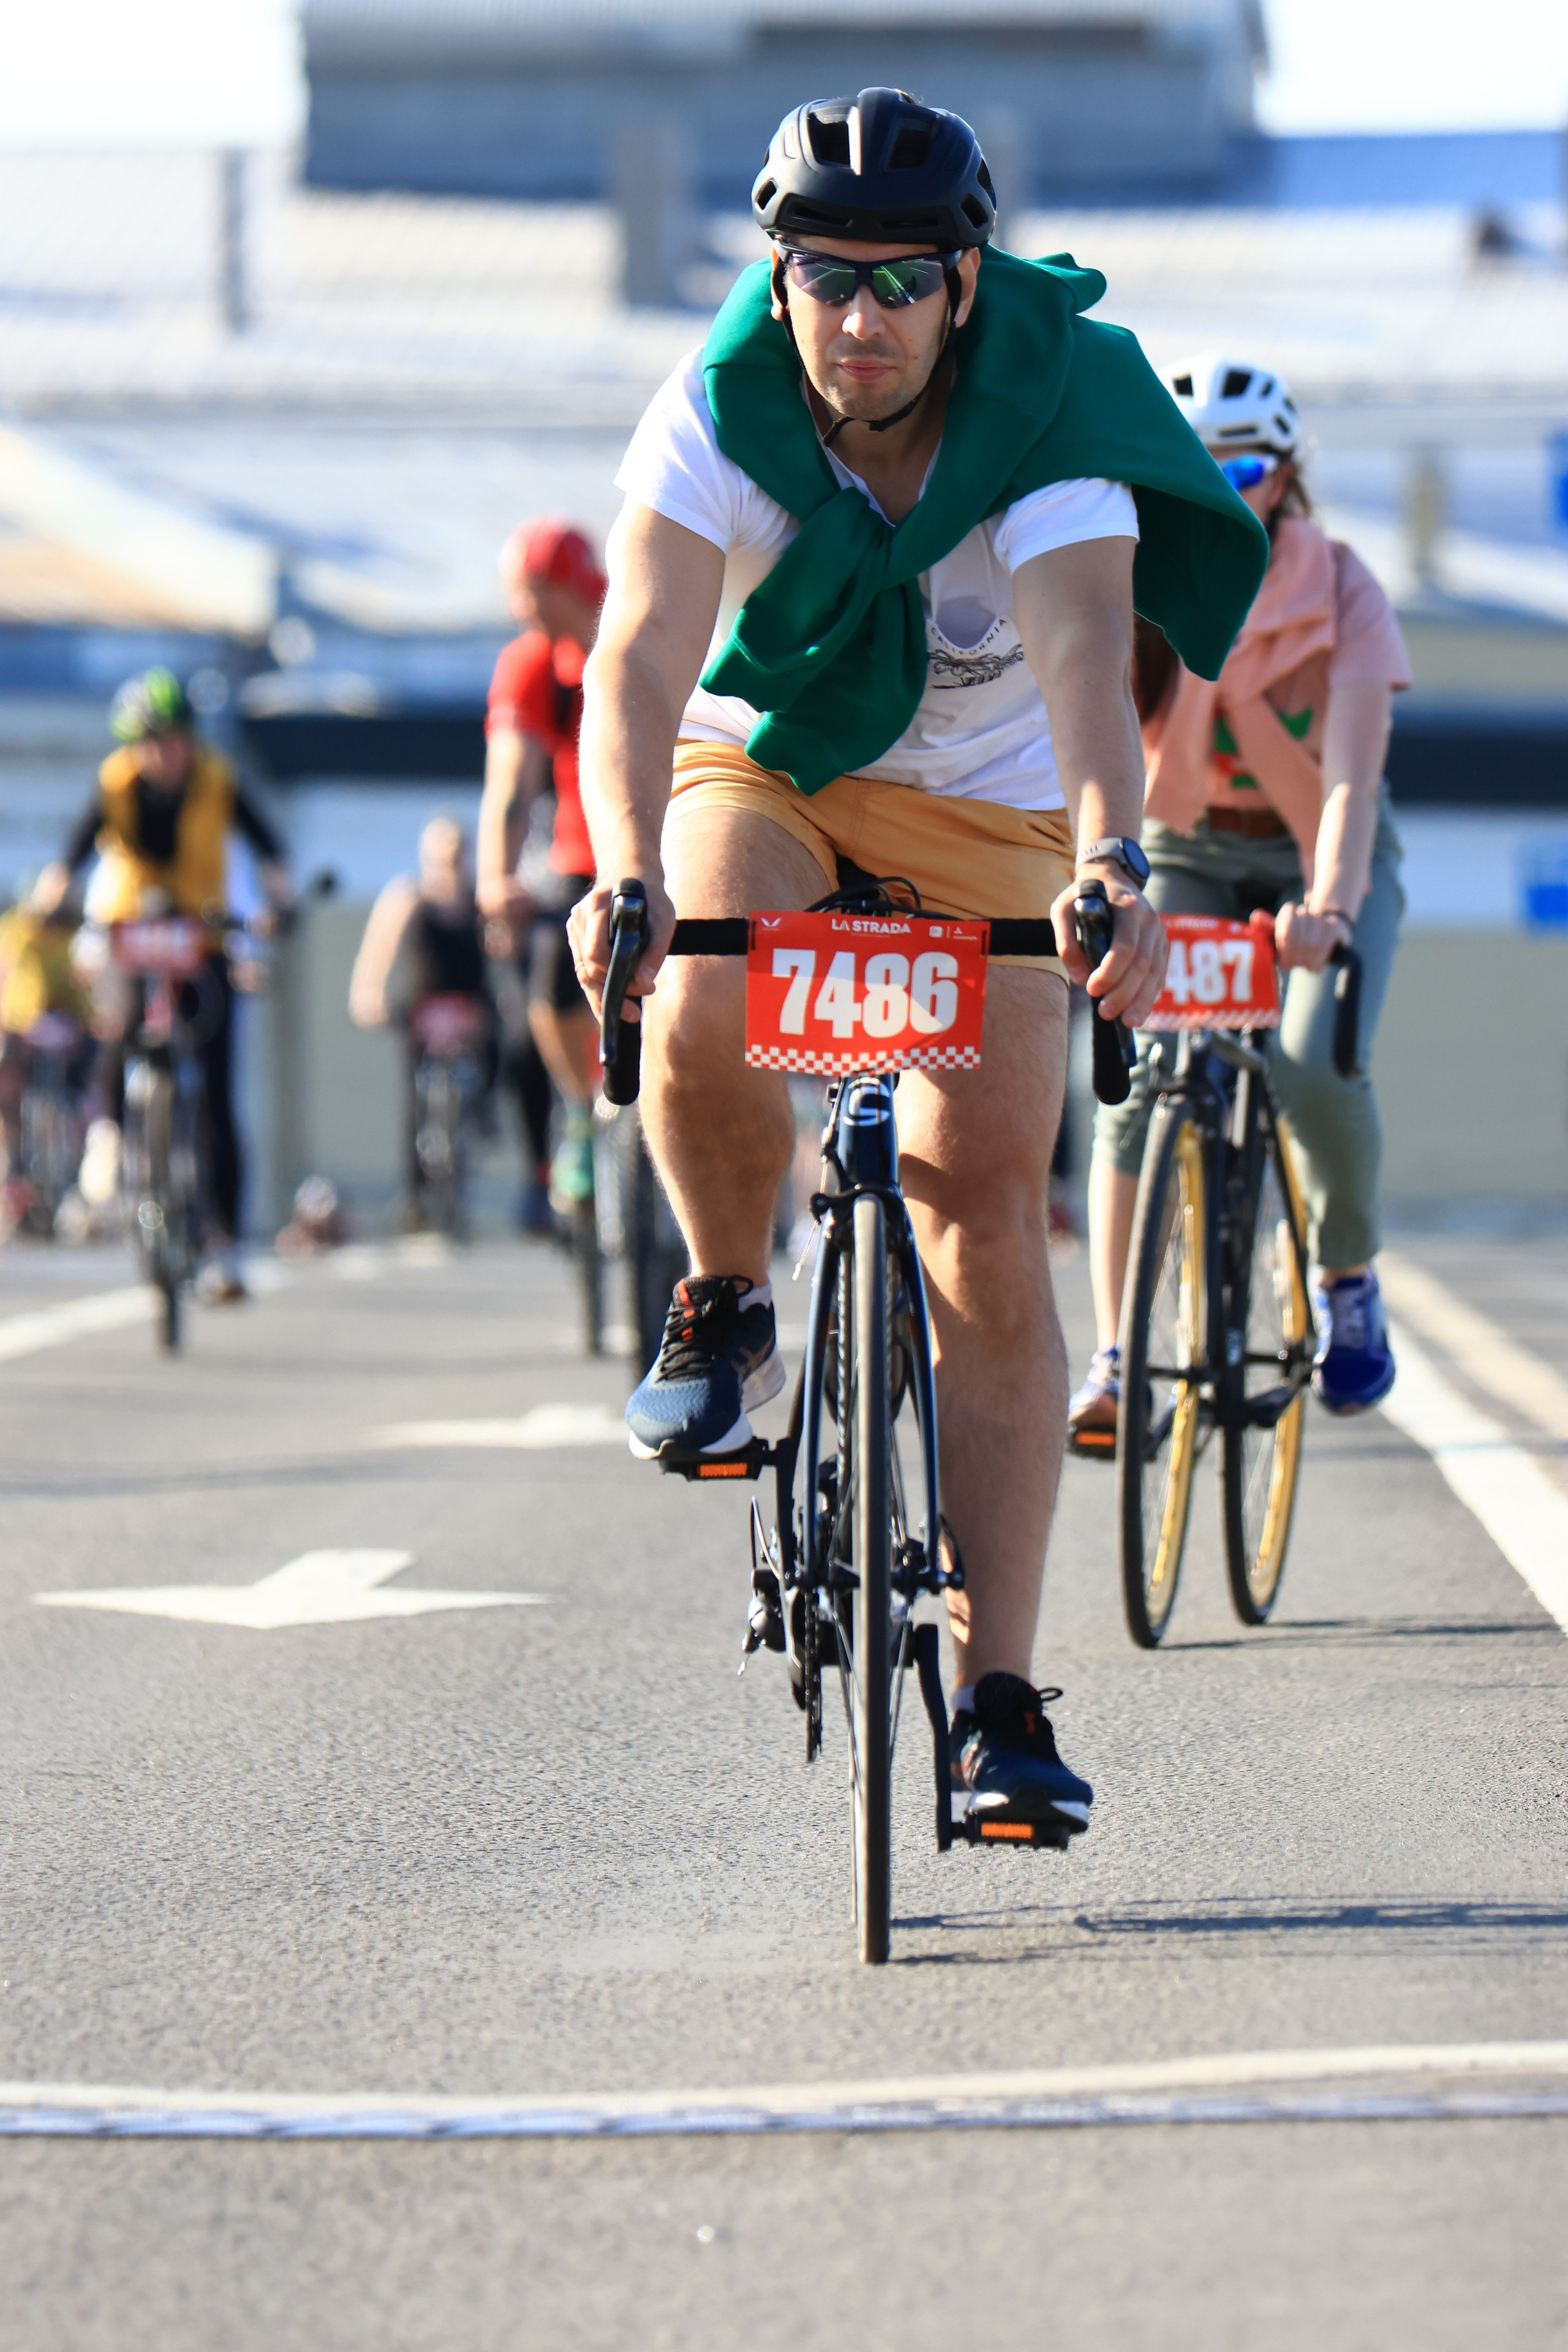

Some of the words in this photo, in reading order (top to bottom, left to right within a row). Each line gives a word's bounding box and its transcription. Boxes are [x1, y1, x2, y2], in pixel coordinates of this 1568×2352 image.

[832, 919, 850, 931] LA
[853, 921, 911, 934] STRADA
[772, 948, 959, 1039] 7486
[1154, 940, 1254, 1005] 487
